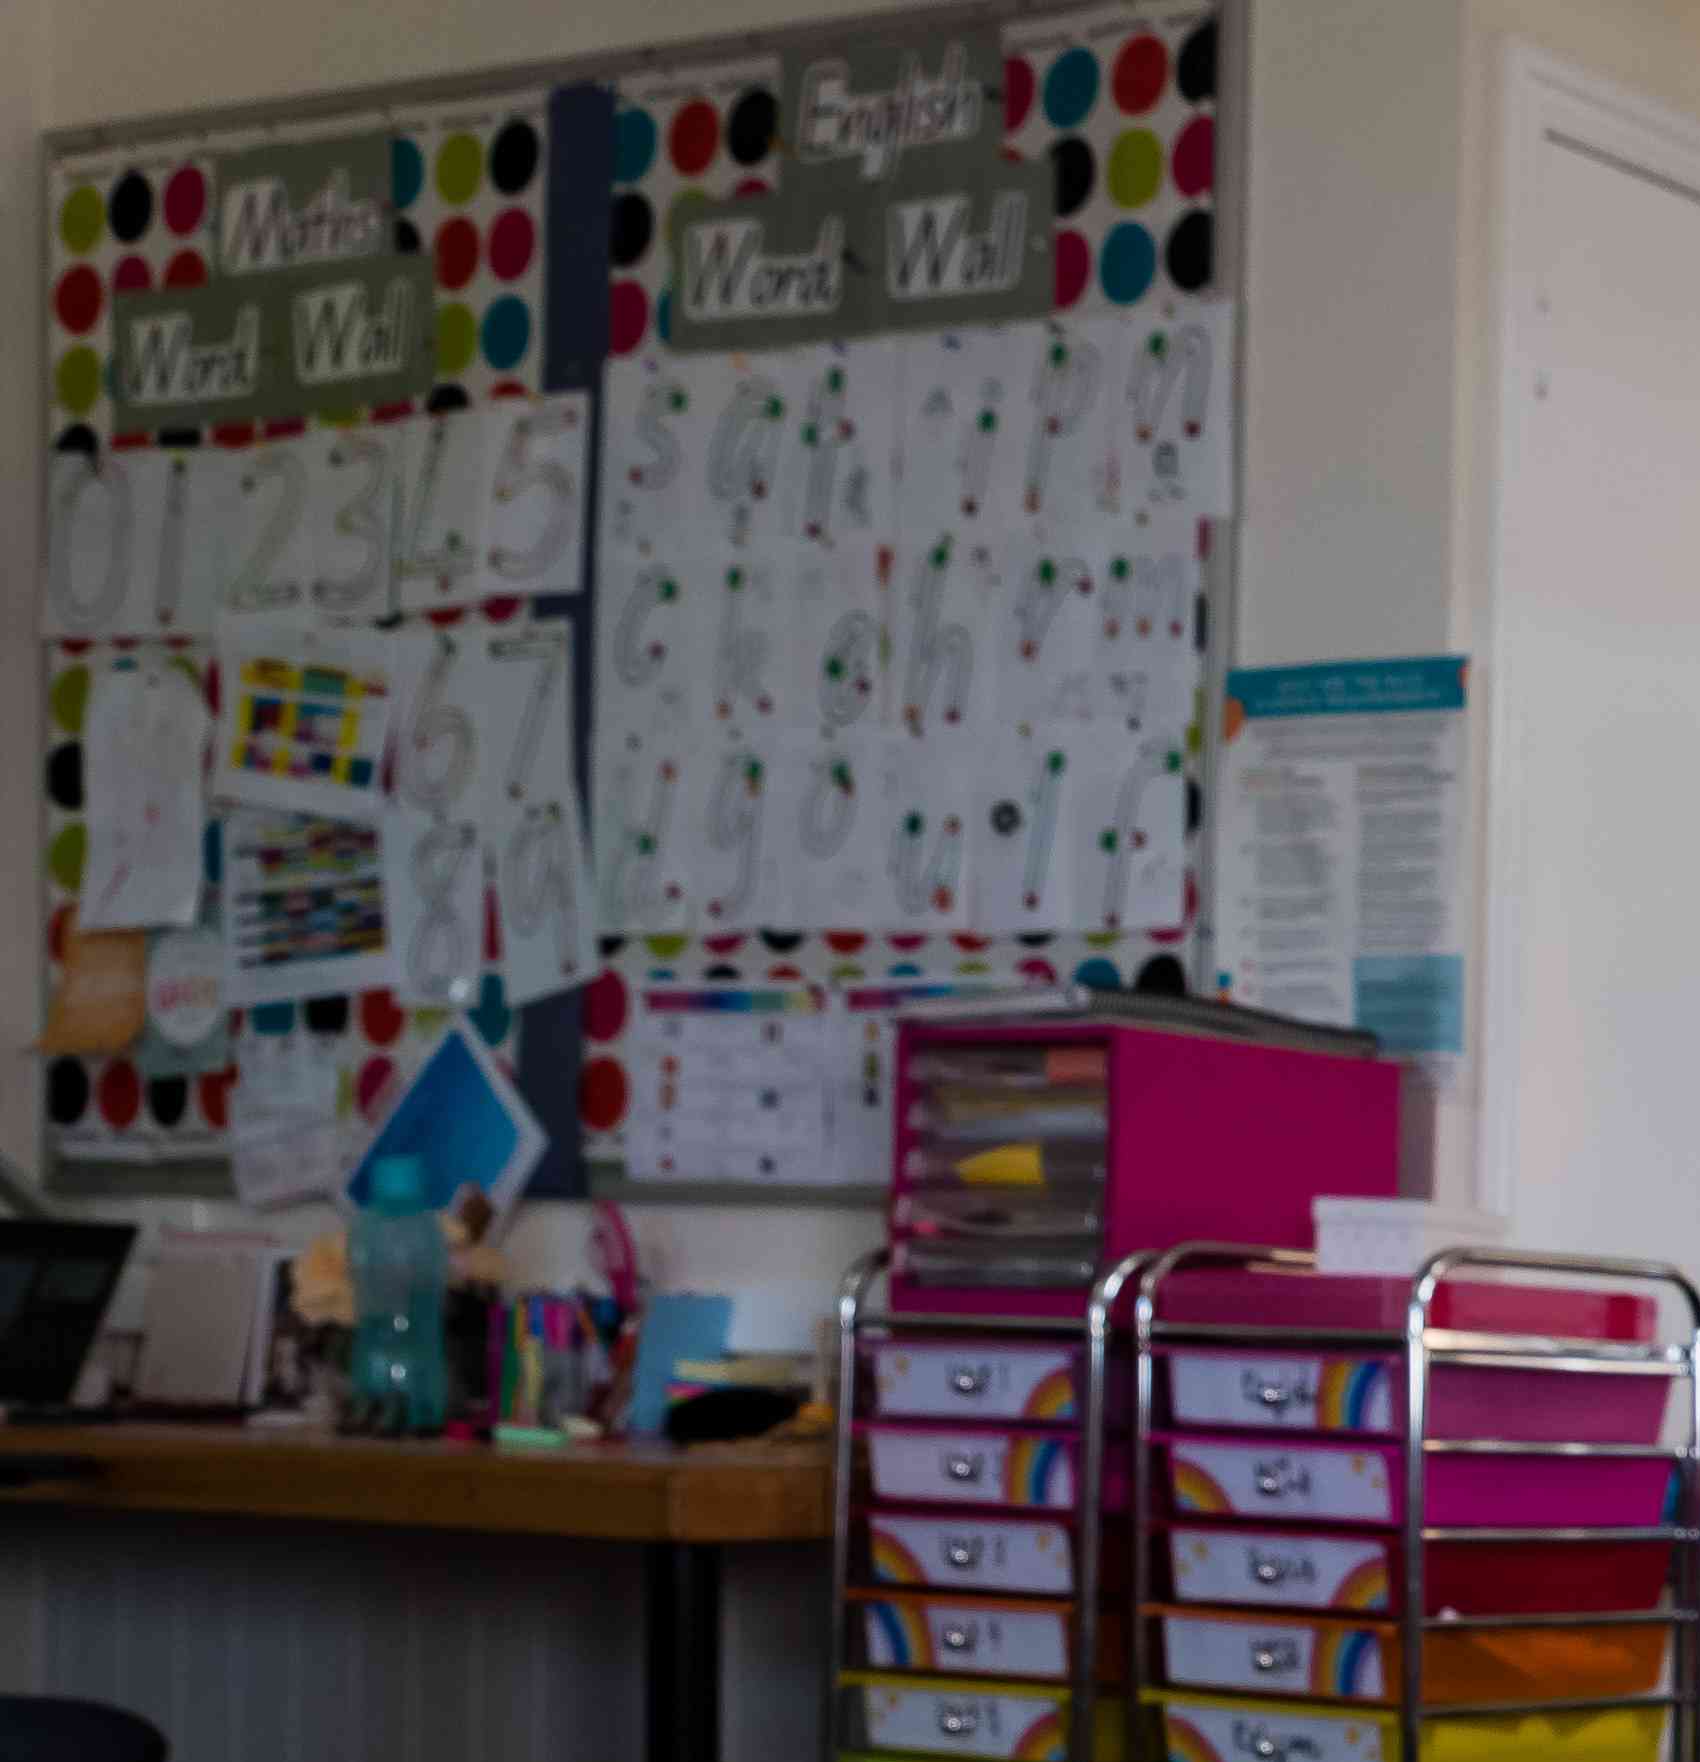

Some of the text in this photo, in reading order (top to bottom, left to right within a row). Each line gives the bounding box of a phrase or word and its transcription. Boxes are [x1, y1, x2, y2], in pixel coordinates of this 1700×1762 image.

[802, 44, 980, 170] English
[690, 194, 1023, 308] Word Wall
[130, 280, 412, 397] Word Wall
